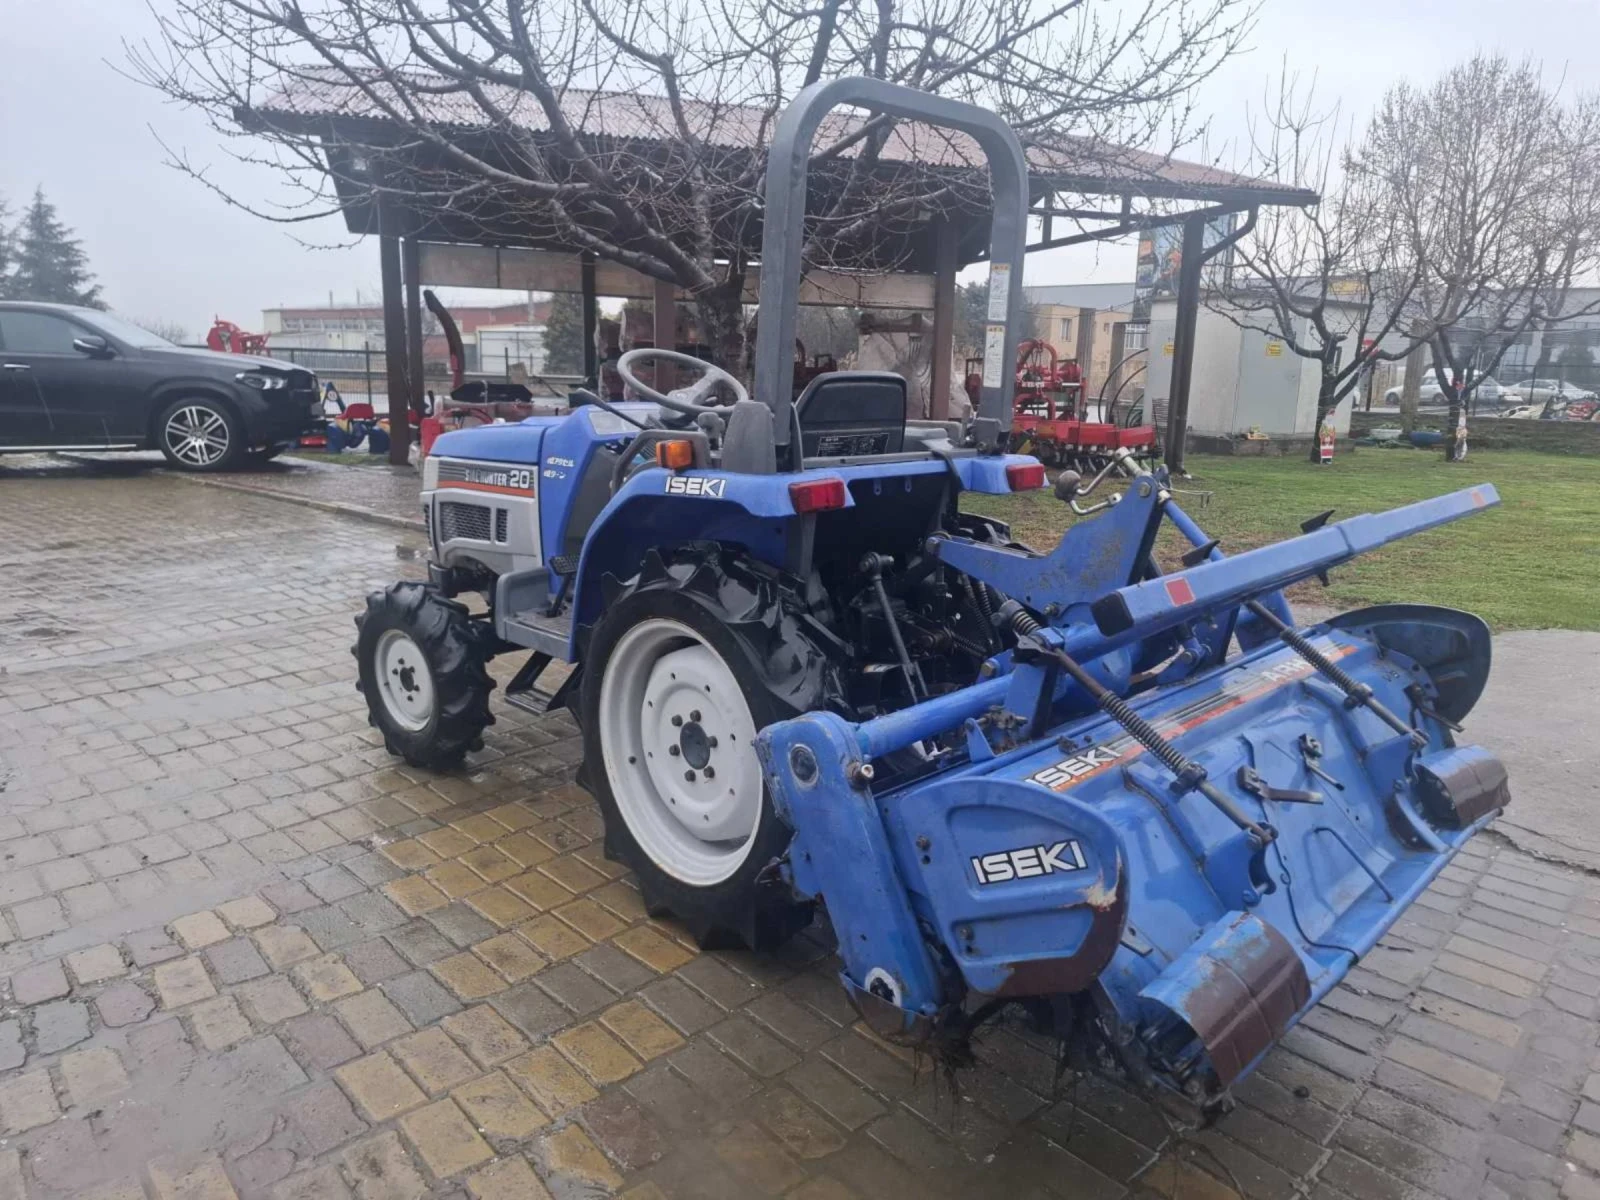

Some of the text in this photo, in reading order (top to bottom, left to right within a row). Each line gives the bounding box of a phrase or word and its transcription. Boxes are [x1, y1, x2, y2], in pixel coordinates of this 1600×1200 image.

[509, 469, 531, 489] 20
[665, 476, 727, 497] ISEKI
[1024, 744, 1123, 791] ISEKI
[971, 839, 1088, 884] ISEKI
